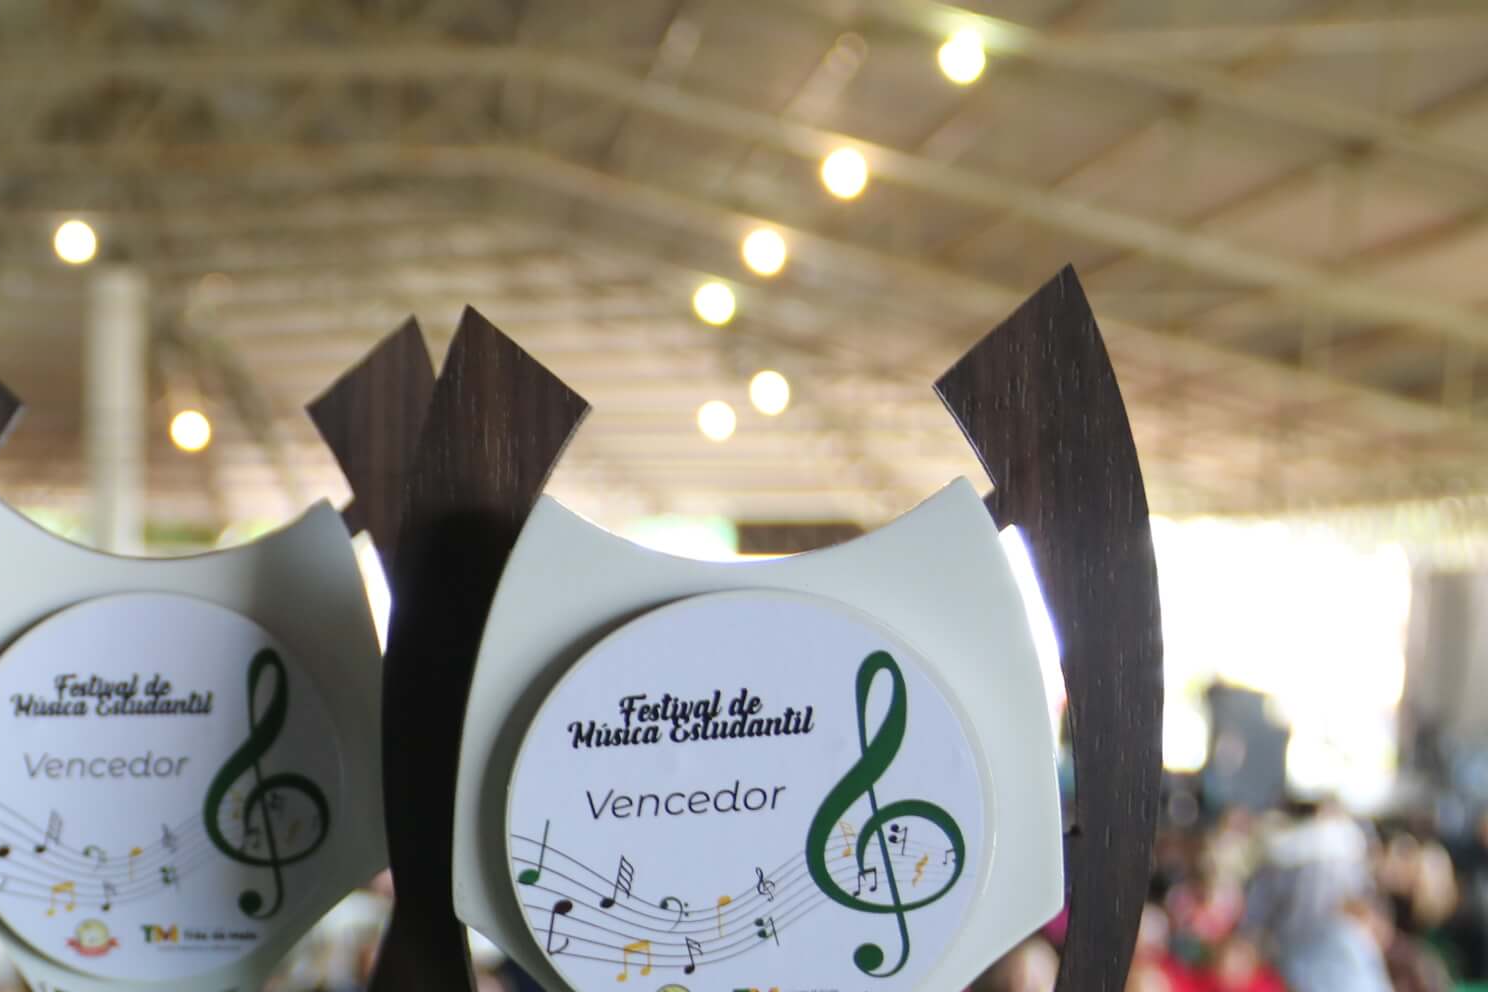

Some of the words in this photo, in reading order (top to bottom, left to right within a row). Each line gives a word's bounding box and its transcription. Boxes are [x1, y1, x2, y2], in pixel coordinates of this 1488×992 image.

[53, 673, 139, 700] Festival
[144, 673, 171, 697] de
[618, 689, 721, 723] Festival
[728, 688, 763, 717] de
[567, 719, 662, 749] Música
[669, 705, 814, 743] Estudantil
[23, 750, 190, 779] Vencedor
[585, 779, 787, 820] Vencedor
